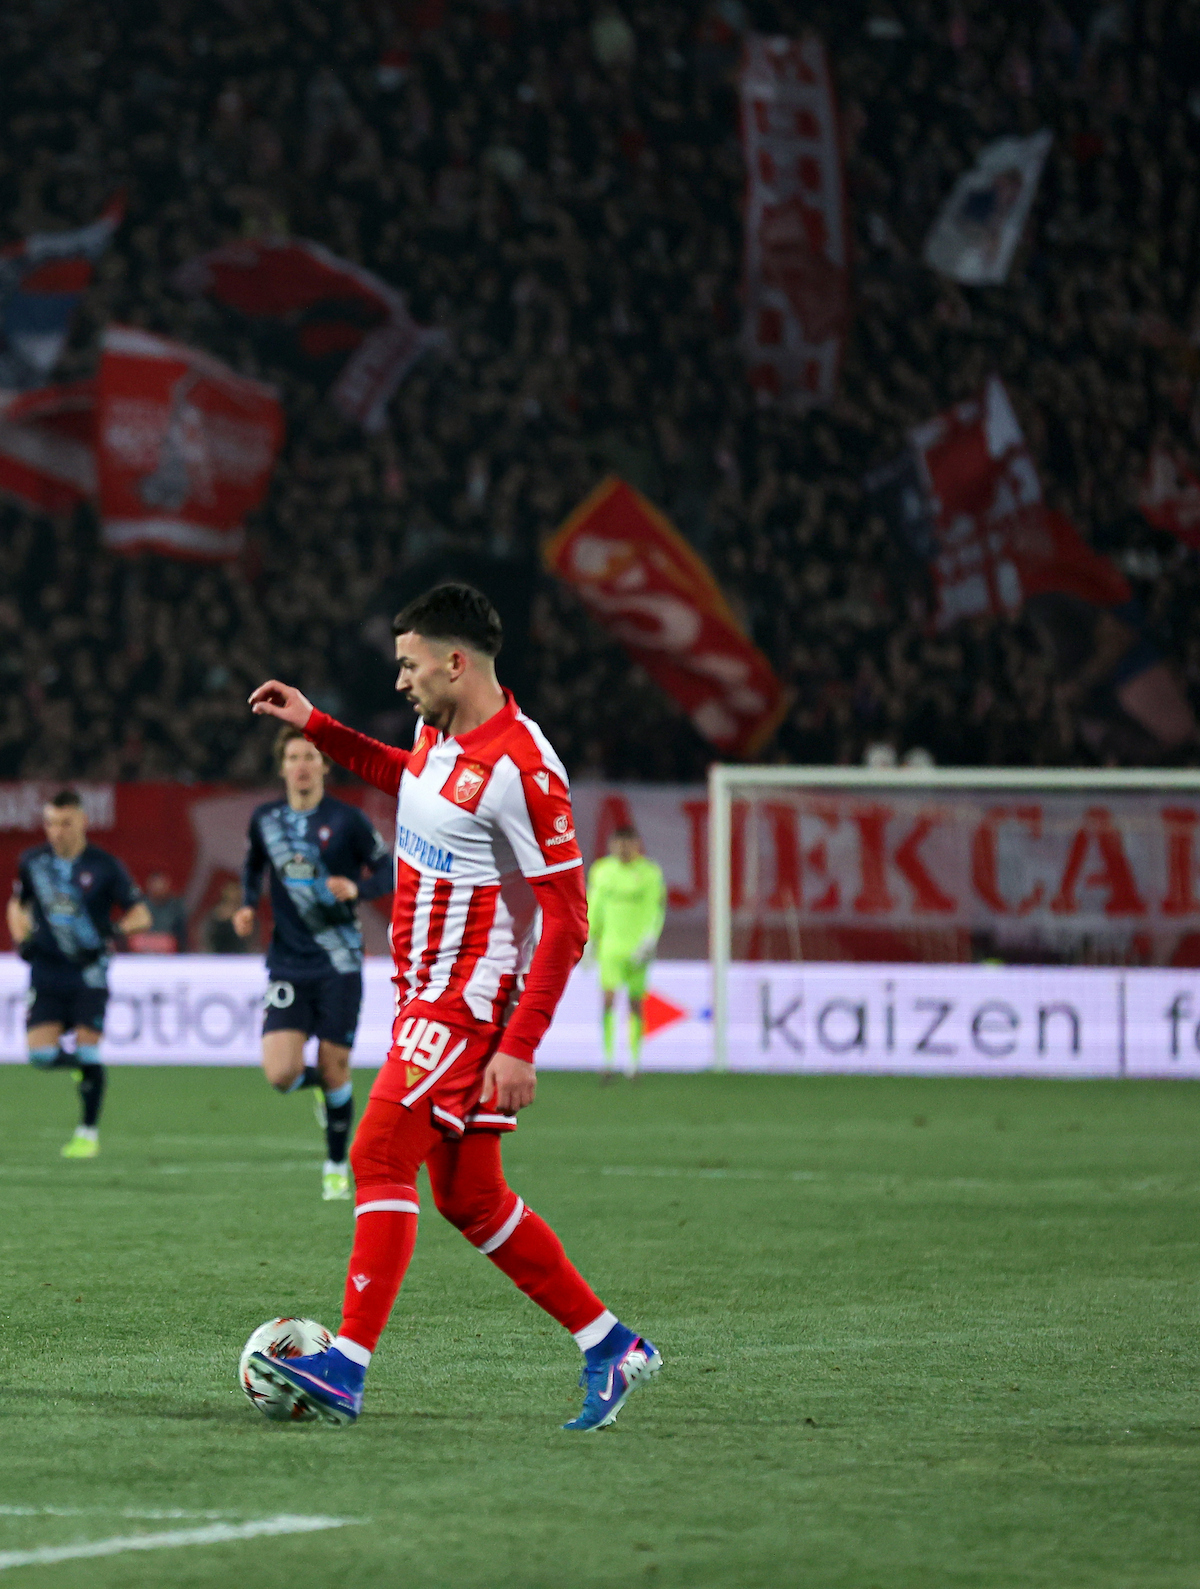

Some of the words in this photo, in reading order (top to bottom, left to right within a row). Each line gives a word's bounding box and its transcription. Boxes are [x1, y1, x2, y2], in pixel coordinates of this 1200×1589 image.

[396, 1017, 452, 1072] 49
[760, 980, 1081, 1057] kaizen
[1165, 990, 1200, 1057] f
